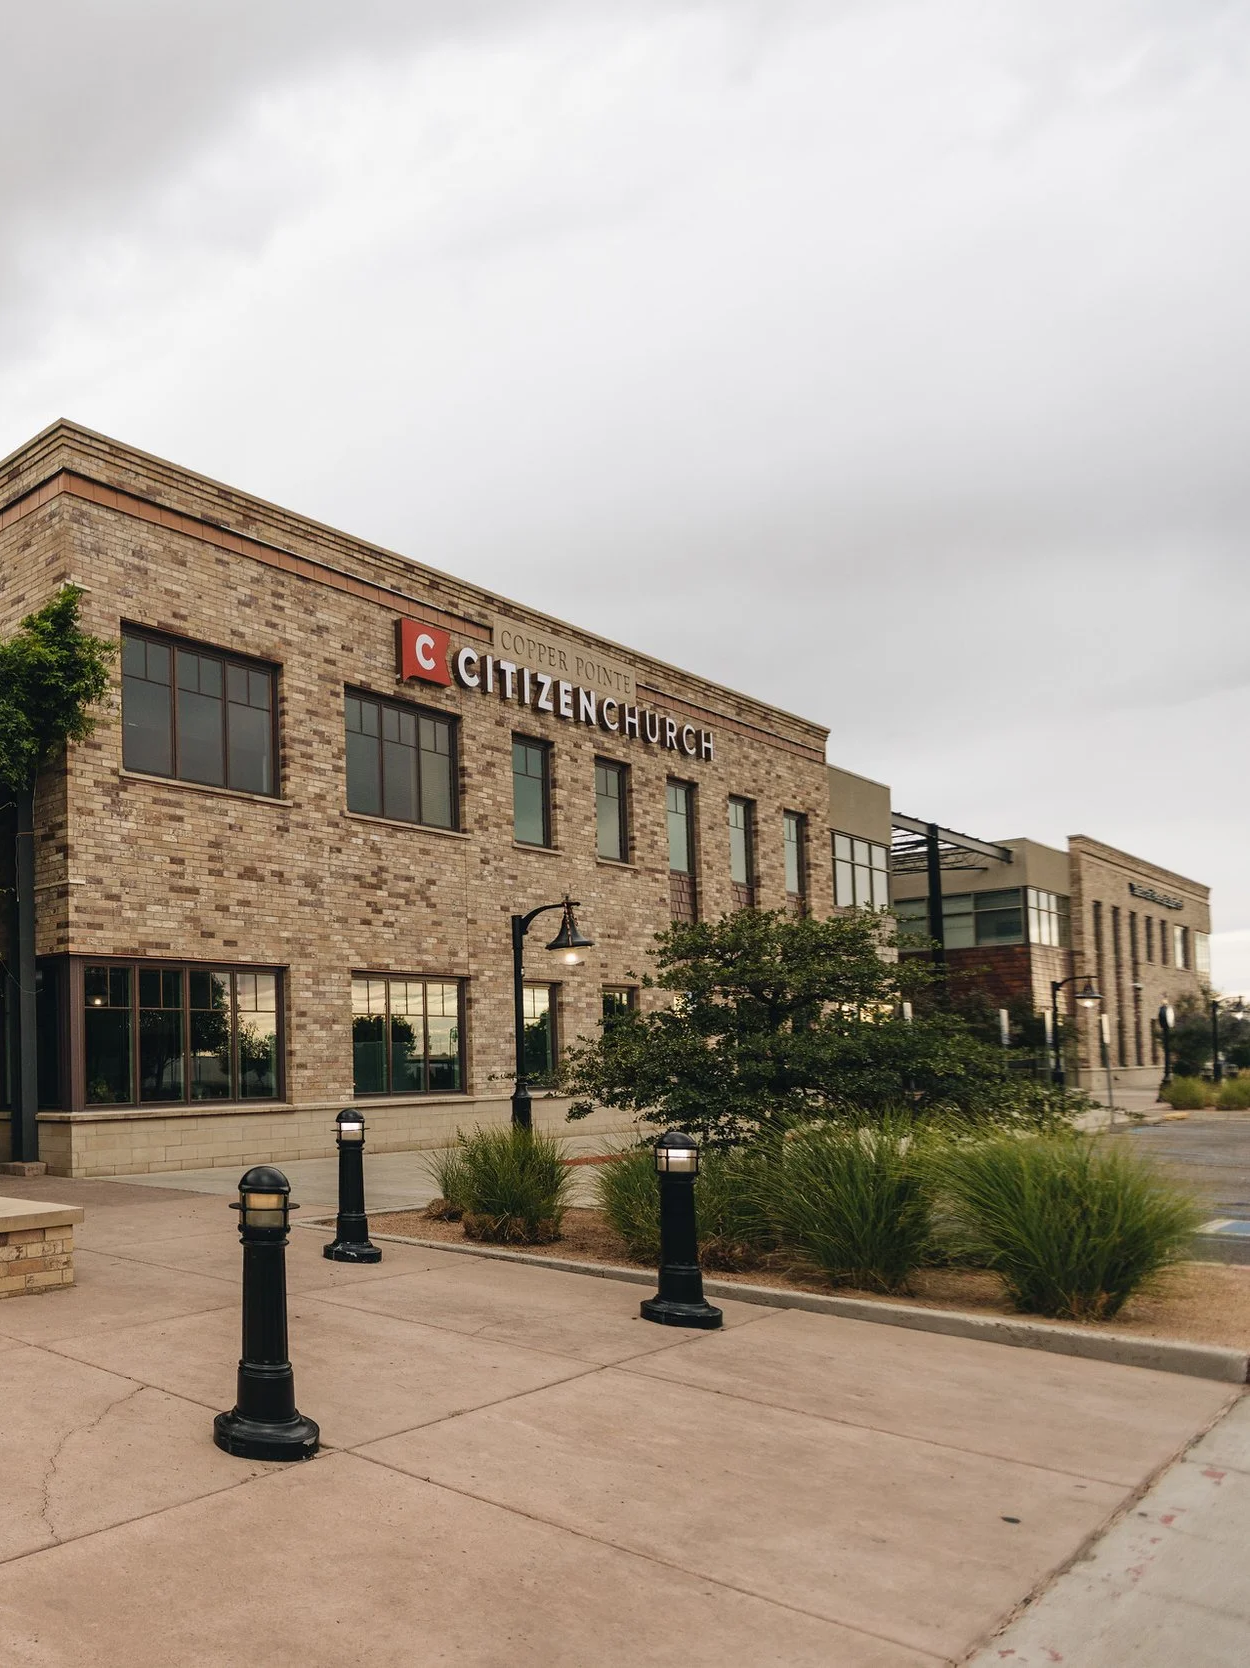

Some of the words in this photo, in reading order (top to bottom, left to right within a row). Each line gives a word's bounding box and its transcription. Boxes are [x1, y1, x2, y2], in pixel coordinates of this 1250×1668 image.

[416, 634, 436, 670] C
[501, 630, 568, 671] COPPER
[576, 656, 631, 694] POINTE
